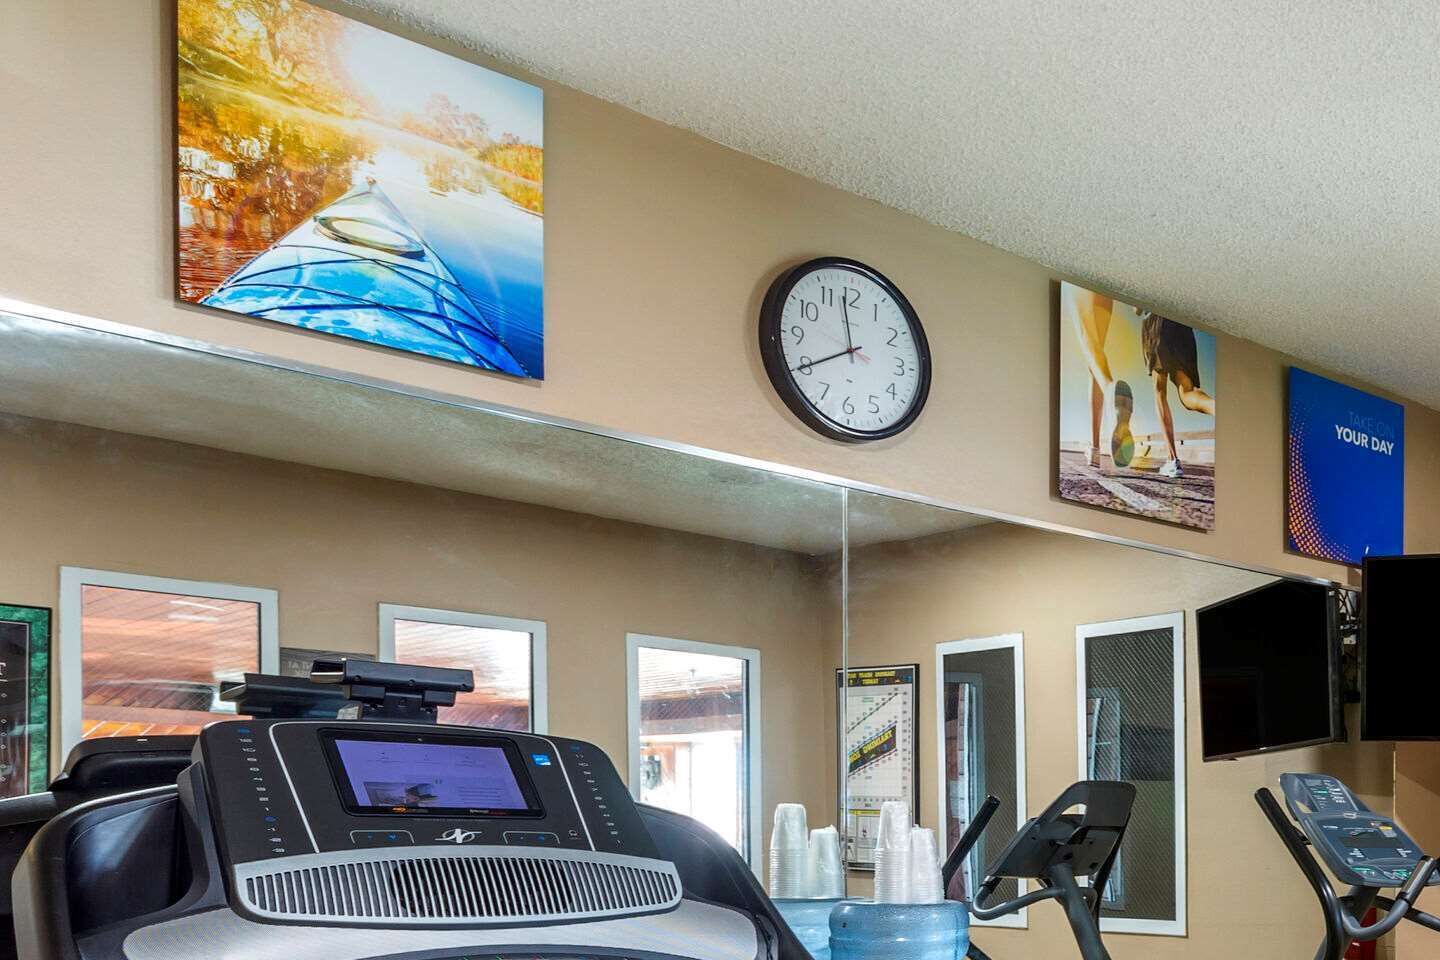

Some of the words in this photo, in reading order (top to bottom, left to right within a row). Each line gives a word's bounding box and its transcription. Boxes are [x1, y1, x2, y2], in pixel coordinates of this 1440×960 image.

[821, 286, 833, 307] 11
[843, 287, 861, 309] 12
[800, 299, 819, 322] 10
[873, 303, 878, 322] 1
[791, 326, 804, 345] 9
[886, 327, 898, 347] 2
[799, 356, 812, 376] 8
[893, 357, 905, 377] 3
[819, 381, 830, 400] 7
[886, 382, 897, 401] 4
[842, 396, 855, 415] 6
[868, 395, 879, 414] 5
[1335, 424, 1369, 449] YOUR
[1371, 436, 1395, 456] DAY
